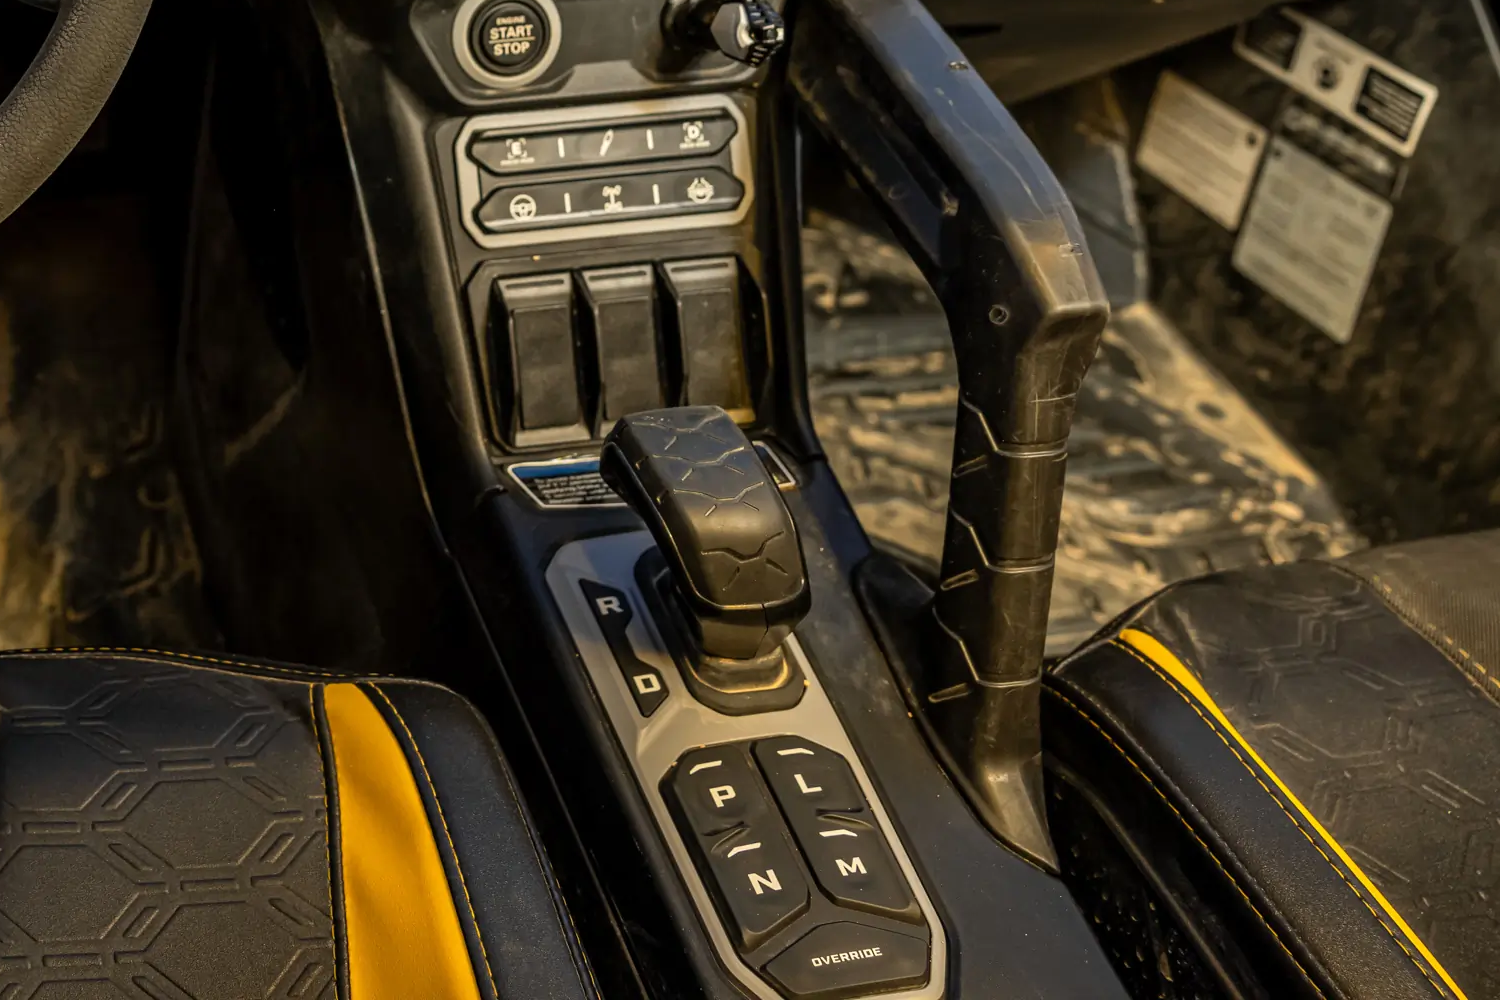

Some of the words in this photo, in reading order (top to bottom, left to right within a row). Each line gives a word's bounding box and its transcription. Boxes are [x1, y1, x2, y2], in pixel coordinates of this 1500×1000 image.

[490, 24, 534, 40] START
[494, 41, 530, 56] STOP
[596, 596, 624, 615] R
[632, 673, 662, 694] D
[794, 774, 822, 794] L
[709, 784, 736, 808] P
[835, 856, 867, 876] M
[748, 869, 782, 895] N
[811, 947, 883, 968] OVERRIDE
